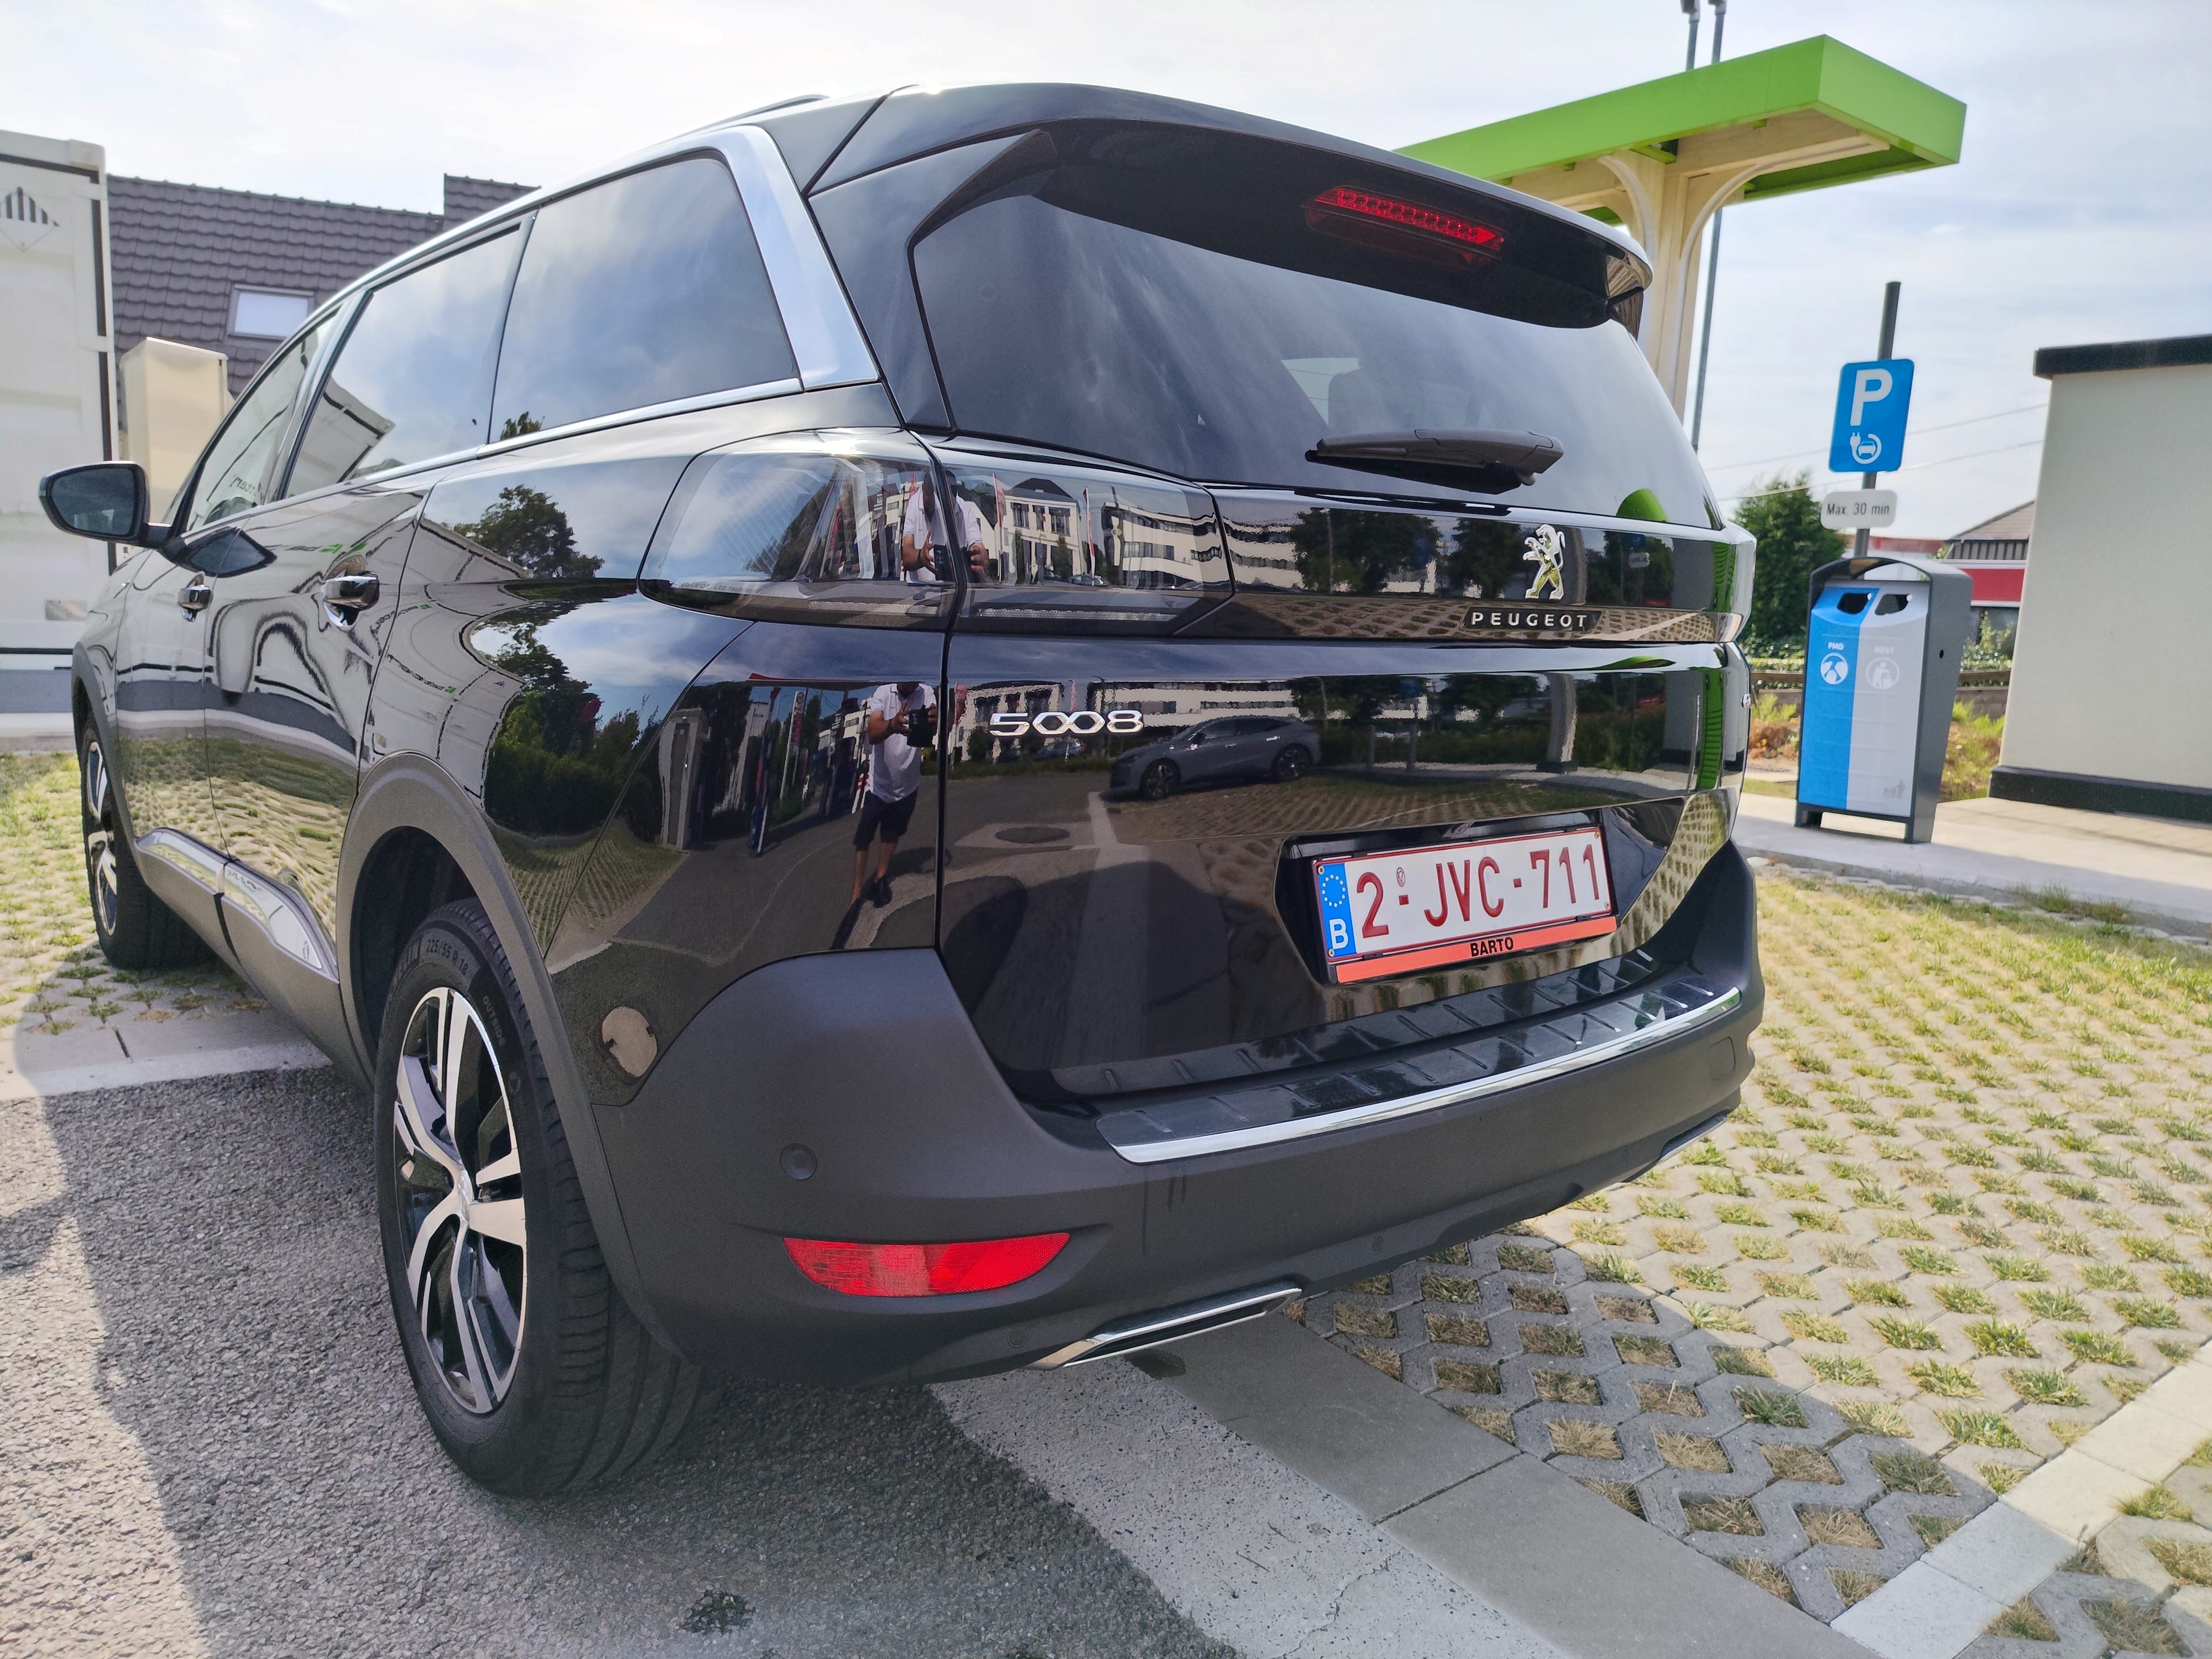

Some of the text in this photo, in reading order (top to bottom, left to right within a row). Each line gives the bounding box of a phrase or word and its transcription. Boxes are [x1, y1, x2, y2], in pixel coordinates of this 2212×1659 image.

[1850, 368, 1892, 426] P
[1853, 502, 1867, 515] 30
[1871, 503, 1889, 515] min
[1470, 611, 1587, 628] PEUGEOT
[989, 709, 1144, 737] 5008
[1329, 917, 1349, 950] B
[1470, 937, 1514, 957] BARTO
[426, 938, 468, 975] 225/55 R 18
[483, 995, 506, 1047] OUTSIDE
